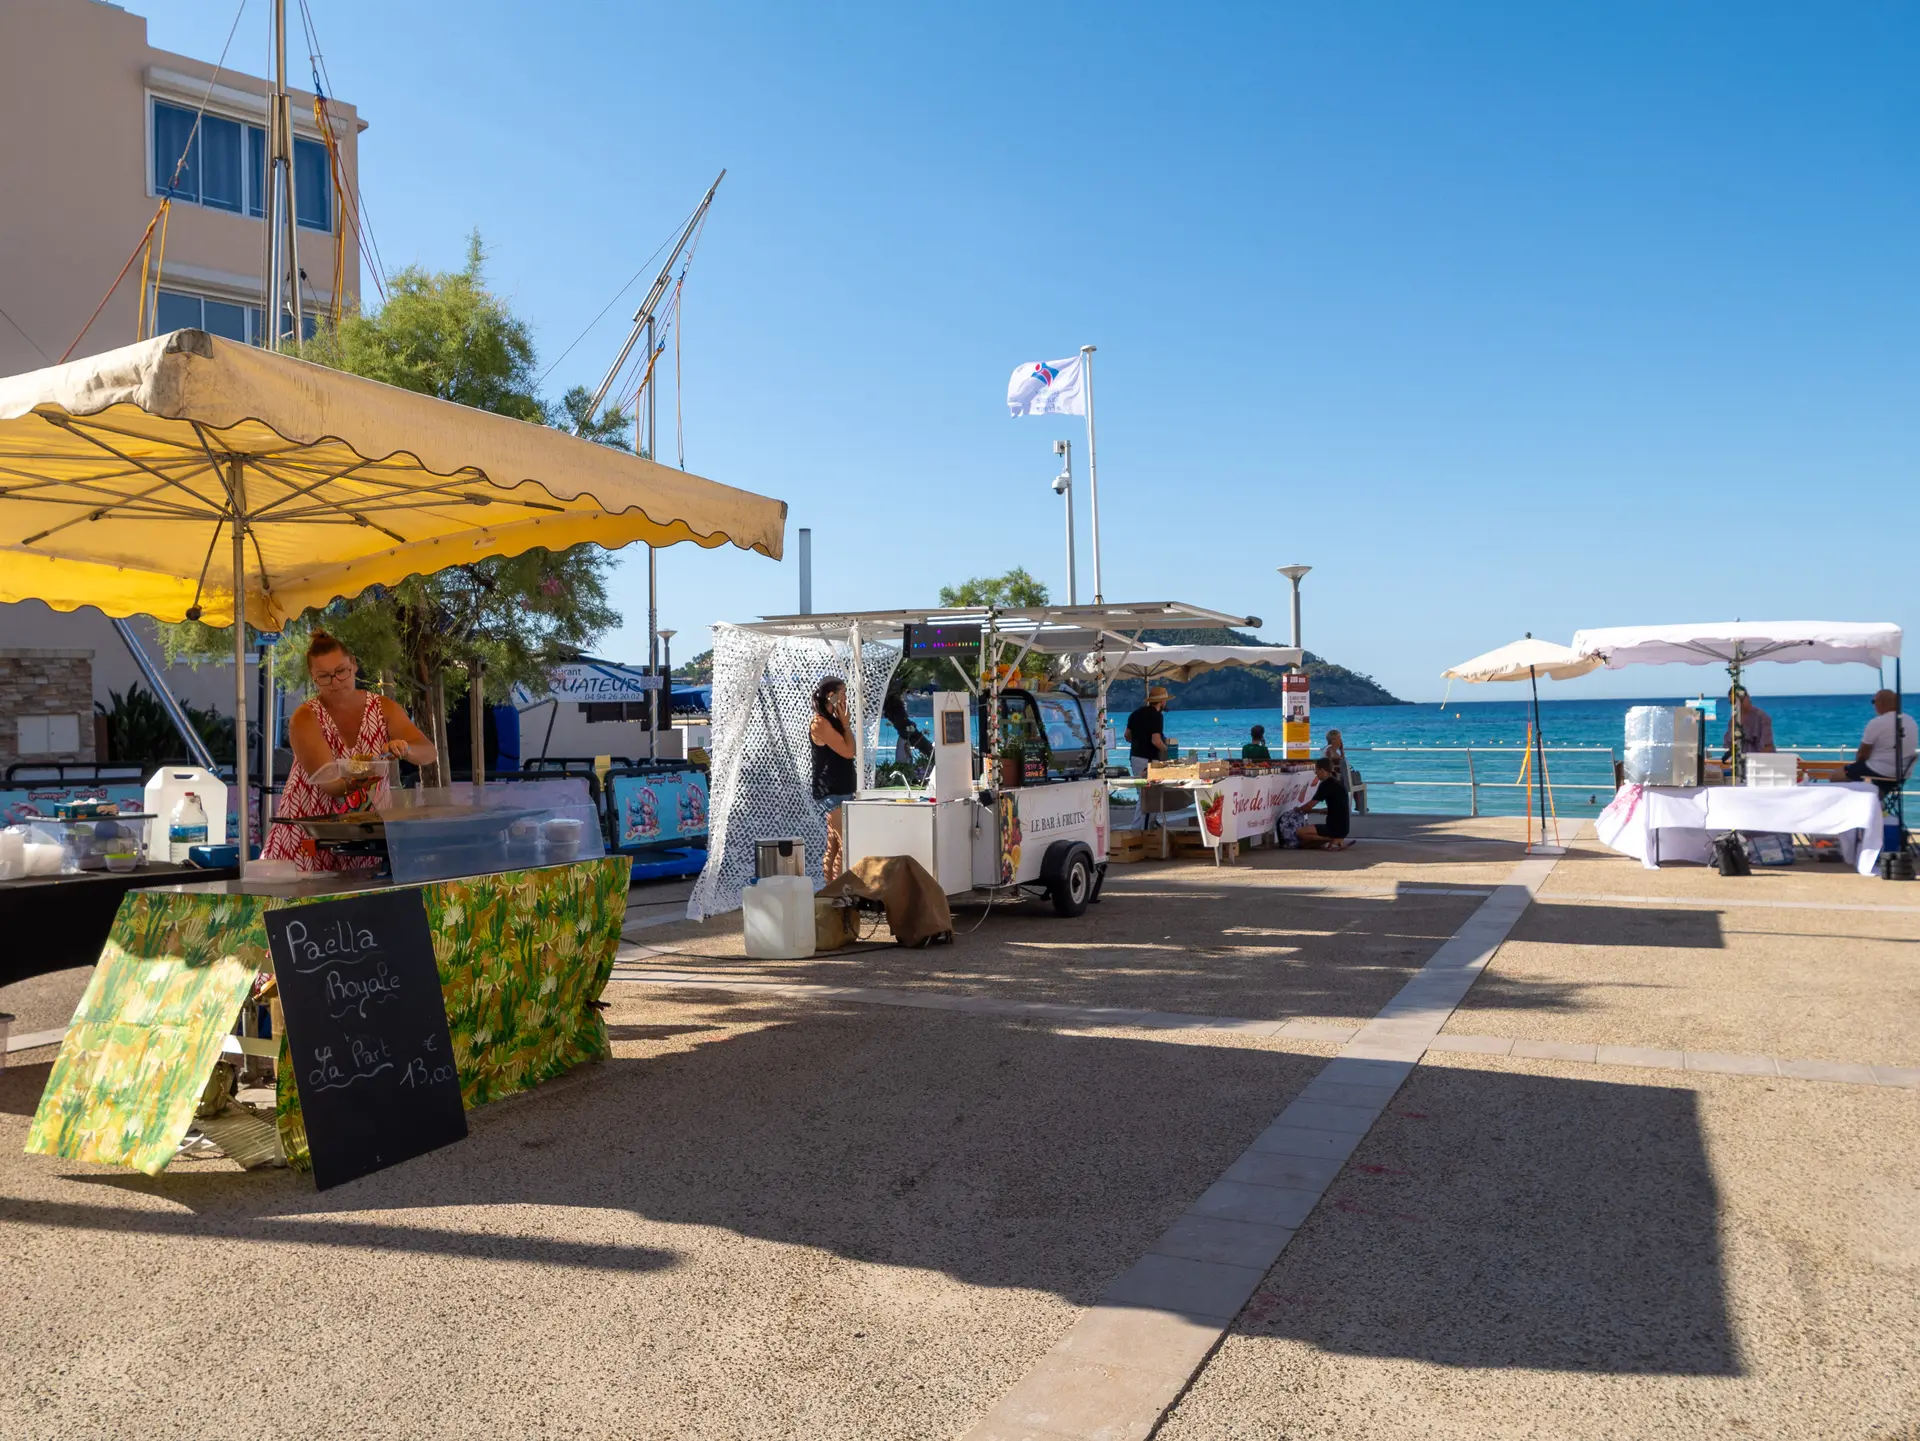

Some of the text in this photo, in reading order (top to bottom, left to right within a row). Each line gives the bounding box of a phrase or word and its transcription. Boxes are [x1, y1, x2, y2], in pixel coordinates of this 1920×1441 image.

[1249, 788, 1264, 812] de
[1030, 819, 1041, 833] LE
[1041, 815, 1056, 831] BAR
[1062, 810, 1086, 827] FRUITS
[286, 920, 378, 964] Paëlla
[326, 962, 401, 1018] Royale
[423, 1033, 437, 1052] €
[309, 1039, 454, 1089] La Part 13,00
